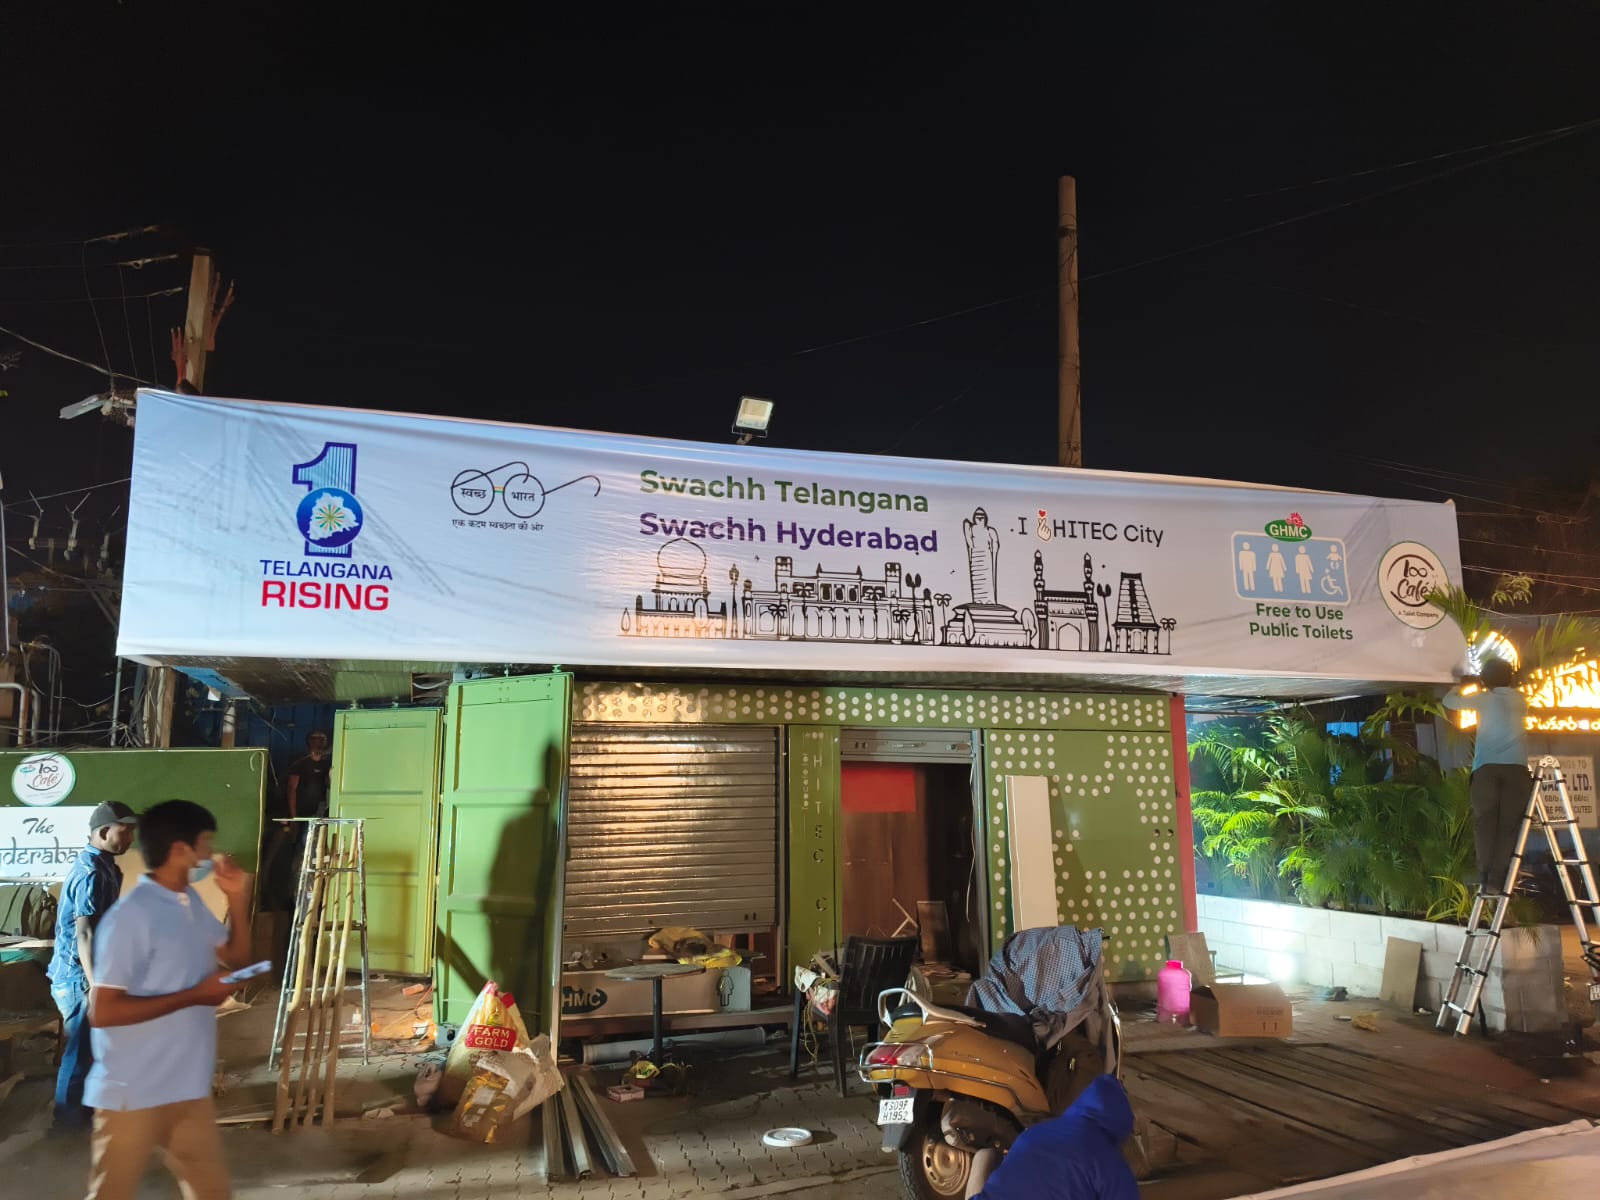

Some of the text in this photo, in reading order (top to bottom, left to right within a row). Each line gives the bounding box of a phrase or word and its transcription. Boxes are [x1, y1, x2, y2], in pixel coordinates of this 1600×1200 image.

[460, 487, 535, 502] स्वच्छ भारत
[640, 469, 929, 515] Swachh Telangana
[640, 511, 938, 554] Swachh Hyderabad
[1017, 516, 1165, 549] I HITEC City
[1268, 523, 1308, 539] GHMC
[259, 558, 393, 581] TELANGANA
[261, 579, 390, 612] RISING
[1255, 602, 1344, 621] Free to Use
[1248, 621, 1354, 641] Public Toilets
[1572, 773, 1592, 791] LTD.
[22, 817, 55, 835] The
[0, 836, 79, 866] deraba
[561, 990, 601, 1007] HMC
[473, 1026, 510, 1038] FARM
[474, 1036, 509, 1048] GOLD
